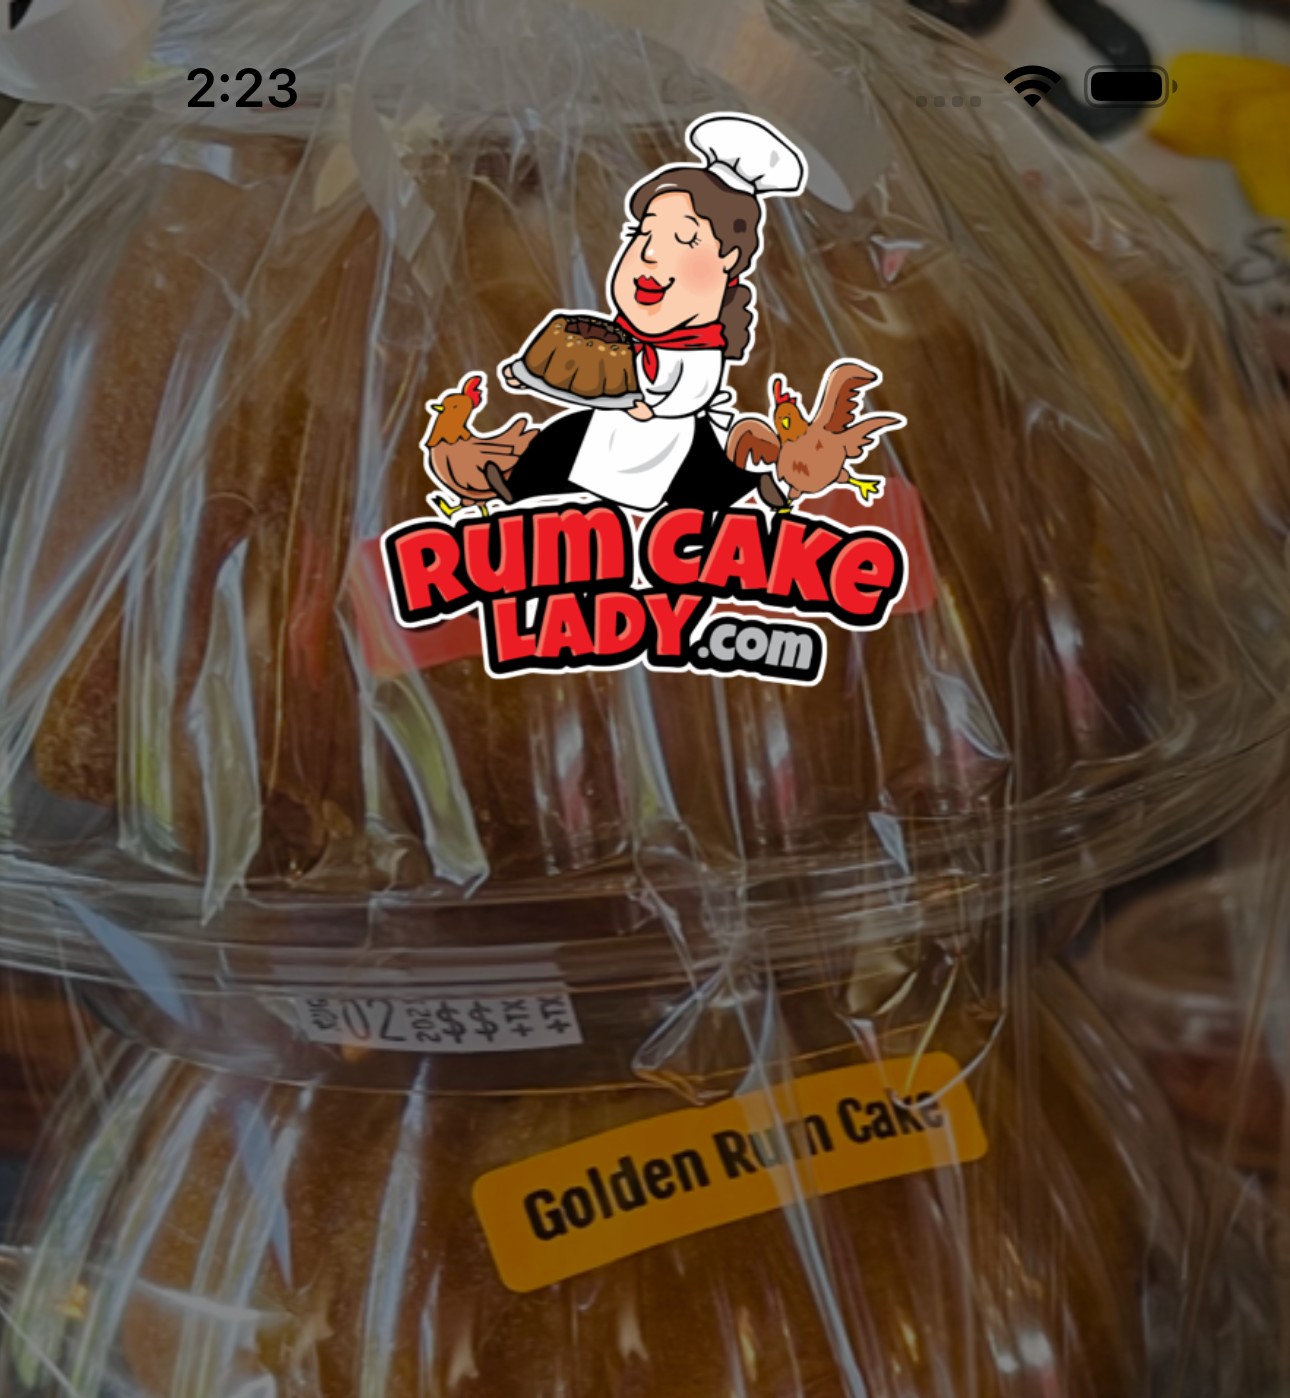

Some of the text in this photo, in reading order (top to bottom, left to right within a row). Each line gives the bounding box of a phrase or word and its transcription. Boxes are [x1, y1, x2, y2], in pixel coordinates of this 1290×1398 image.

[523, 1090, 945, 1242] Golden Rum Cake
